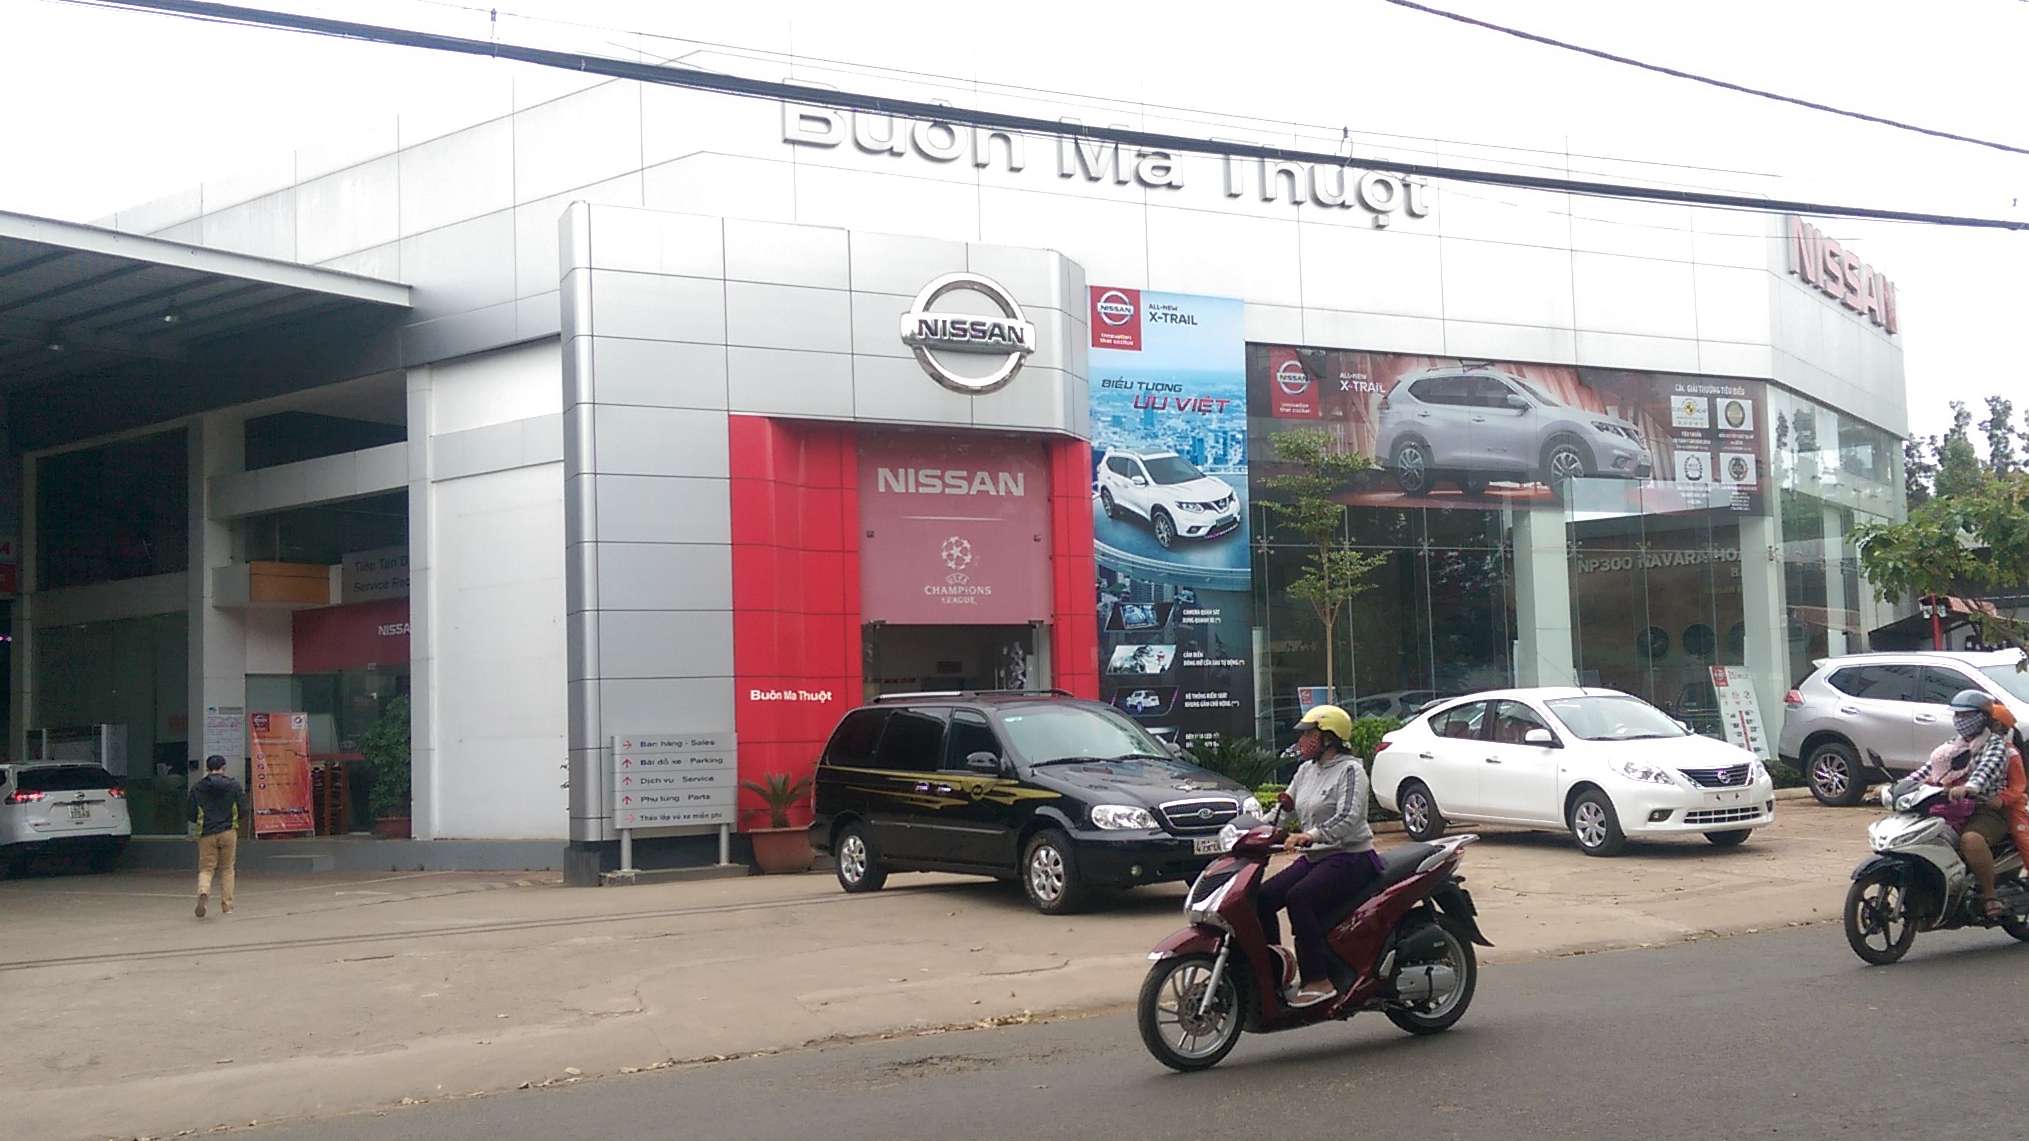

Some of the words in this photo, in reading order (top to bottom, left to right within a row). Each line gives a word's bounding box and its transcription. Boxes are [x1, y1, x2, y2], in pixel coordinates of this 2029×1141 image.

[1057, 115, 1185, 190] Ma
[1787, 213, 1898, 335] NISSAN
[1100, 305, 1132, 314] NISSAN
[1148, 303, 1178, 312] ALL-NEW
[1149, 311, 1199, 326] X-TRAIL
[918, 319, 1025, 344] NISSAN
[1340, 380, 1387, 394] X-TRAIL
[877, 467, 1025, 497] NISSAN
[1578, 556, 1633, 574] NP300
[924, 585, 992, 596] CHAMPIONS
[378, 623, 411, 636] NISSA
[750, 689, 782, 701] Buôn
[784, 690, 798, 701] Ma
[799, 690, 833, 704] Thuột
[690, 757, 724, 765] Parking
[682, 775, 715, 783] Service
[687, 793, 711, 801] Parts
